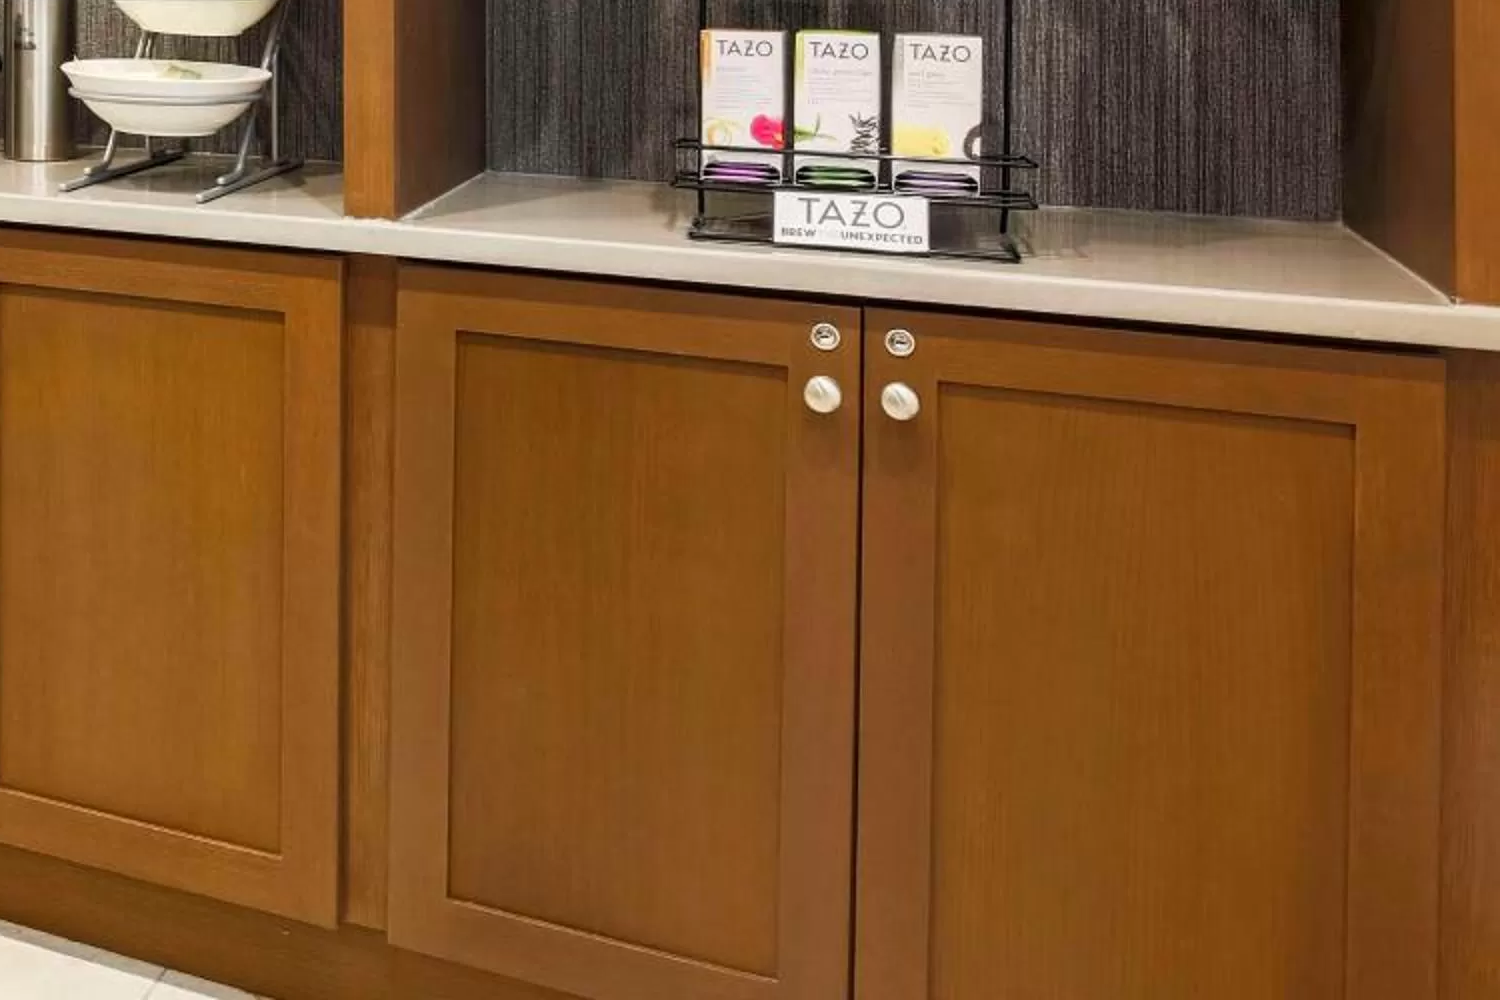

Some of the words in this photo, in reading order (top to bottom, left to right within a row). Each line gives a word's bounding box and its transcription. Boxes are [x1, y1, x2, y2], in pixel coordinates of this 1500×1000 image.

[716, 40, 773, 57] TAZO
[809, 41, 869, 60] TAZO
[909, 43, 971, 62] TAZO
[798, 197, 904, 229] TAZO
[781, 227, 816, 237] BREW
[840, 231, 923, 245] UNEXPECTED
